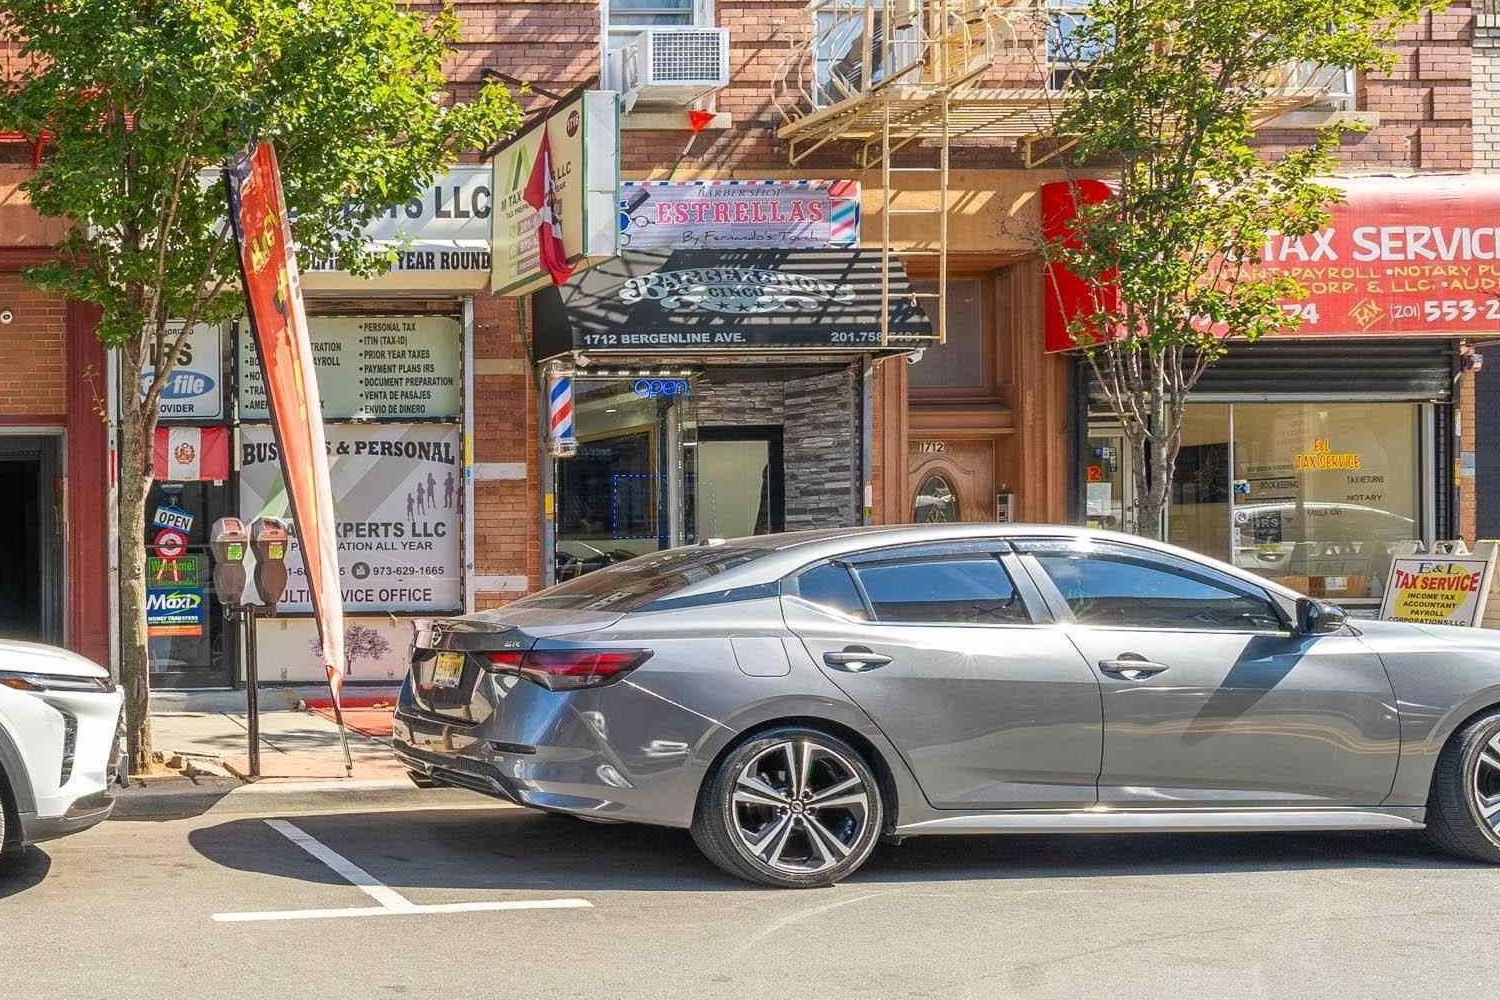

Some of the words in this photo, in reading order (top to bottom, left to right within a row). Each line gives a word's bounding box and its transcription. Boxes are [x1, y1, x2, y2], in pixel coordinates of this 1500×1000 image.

[436, 185, 491, 219] LLC
[656, 200, 823, 225] ESTRELLAS
[682, 231, 700, 244] By
[1265, 226, 1339, 261] TAX
[398, 251, 435, 270] YEAR
[441, 251, 491, 270] ROUND
[1292, 267, 1380, 280] PAYROLL
[1395, 265, 1471, 278] NOTARY
[708, 286, 764, 298] CINCO
[1367, 280, 1383, 294] &
[1355, 301, 1381, 325] FAX
[1389, 303, 1421, 320] (201)
[364, 323, 400, 332] PERSONAL
[402, 322, 416, 331] TAX
[364, 336, 379, 345] ITIN
[584, 334, 617, 345] 1712
[621, 332, 712, 344] BERGENLINE
[714, 332, 746, 343] AVE.
[364, 350, 386, 359] PRIOR
[388, 350, 407, 359] YEAR
[408, 350, 430, 359] TAXES
[313, 357, 341, 366] AYROLL
[364, 364, 396, 374] PAYMENT
[399, 364, 422, 373] PLANS
[423, 364, 435, 373] IRS
[364, 377, 403, 387] DOCUMENT
[405, 377, 453, 386] PREPARATION
[364, 391, 388, 400] VENTA
[389, 391, 399, 400] DE
[400, 390, 431, 400] PASAJES
[633, 379, 690, 399] Open
[160, 404, 195, 413] OVIDER
[364, 405, 388, 414] ENVIO
[389, 404, 398, 413] DE
[399, 404, 426, 414] DINERO
[336, 441, 350, 455] &
[355, 440, 455, 466] PERSONAL
[918, 441, 945, 453] 1712
[158, 511, 190, 530] OPEN
[412, 522, 447, 538] LLC
[376, 541, 398, 551] ALL
[401, 541, 433, 551] YEAR
[373, 566, 445, 576] 973-629-1665
[1394, 569, 1419, 590] TAX
[1420, 571, 1481, 592] SERVICE
[378, 588, 432, 602] OFFICE
[1407, 592, 1438, 600] INCOME
[1403, 601, 1457, 609] ACCOUNTANT
